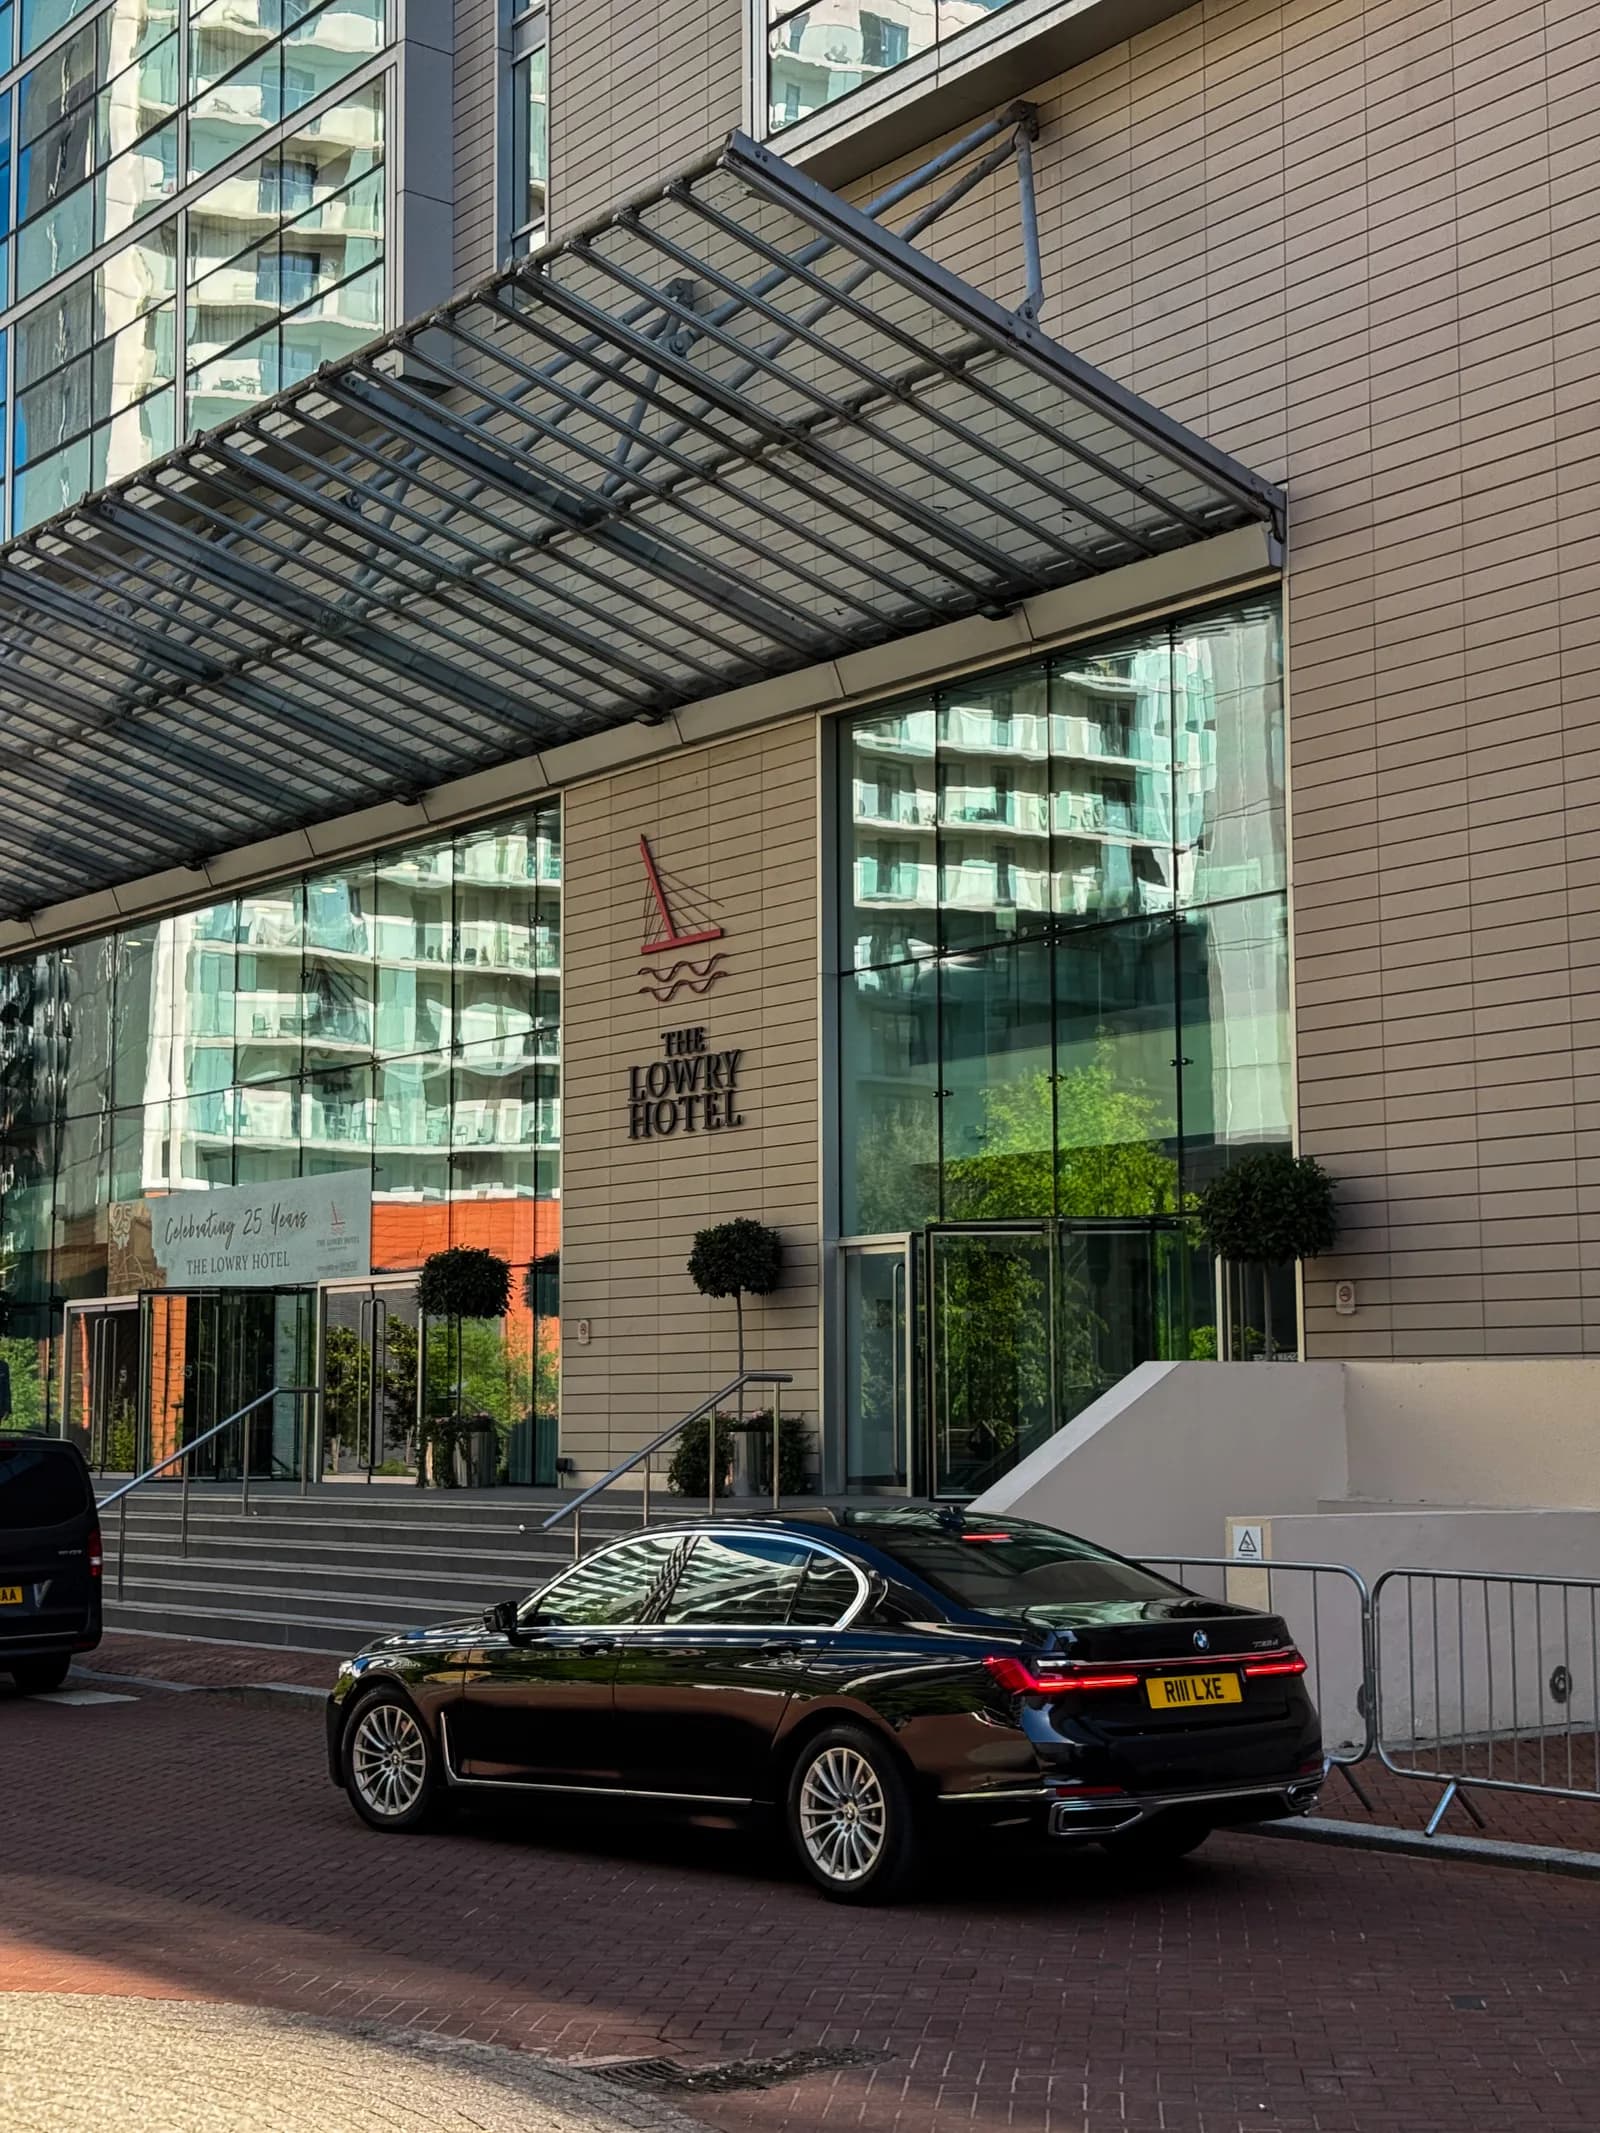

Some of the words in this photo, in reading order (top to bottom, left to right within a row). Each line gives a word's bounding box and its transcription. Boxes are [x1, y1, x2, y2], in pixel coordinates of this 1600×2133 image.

[661, 1026, 706, 1057] THE
[628, 1049, 742, 1102] LOWRY
[628, 1089, 744, 1140] HOTEL
[165, 1208, 236, 1250] Celebrating
[243, 1207, 262, 1236] 25
[271, 1203, 309, 1236] Years
[186, 1258, 208, 1276] THE
[211, 1255, 248, 1274] LOWRY
[252, 1250, 290, 1271] HOTEL
[1192, 1677, 1225, 1702] LXE
